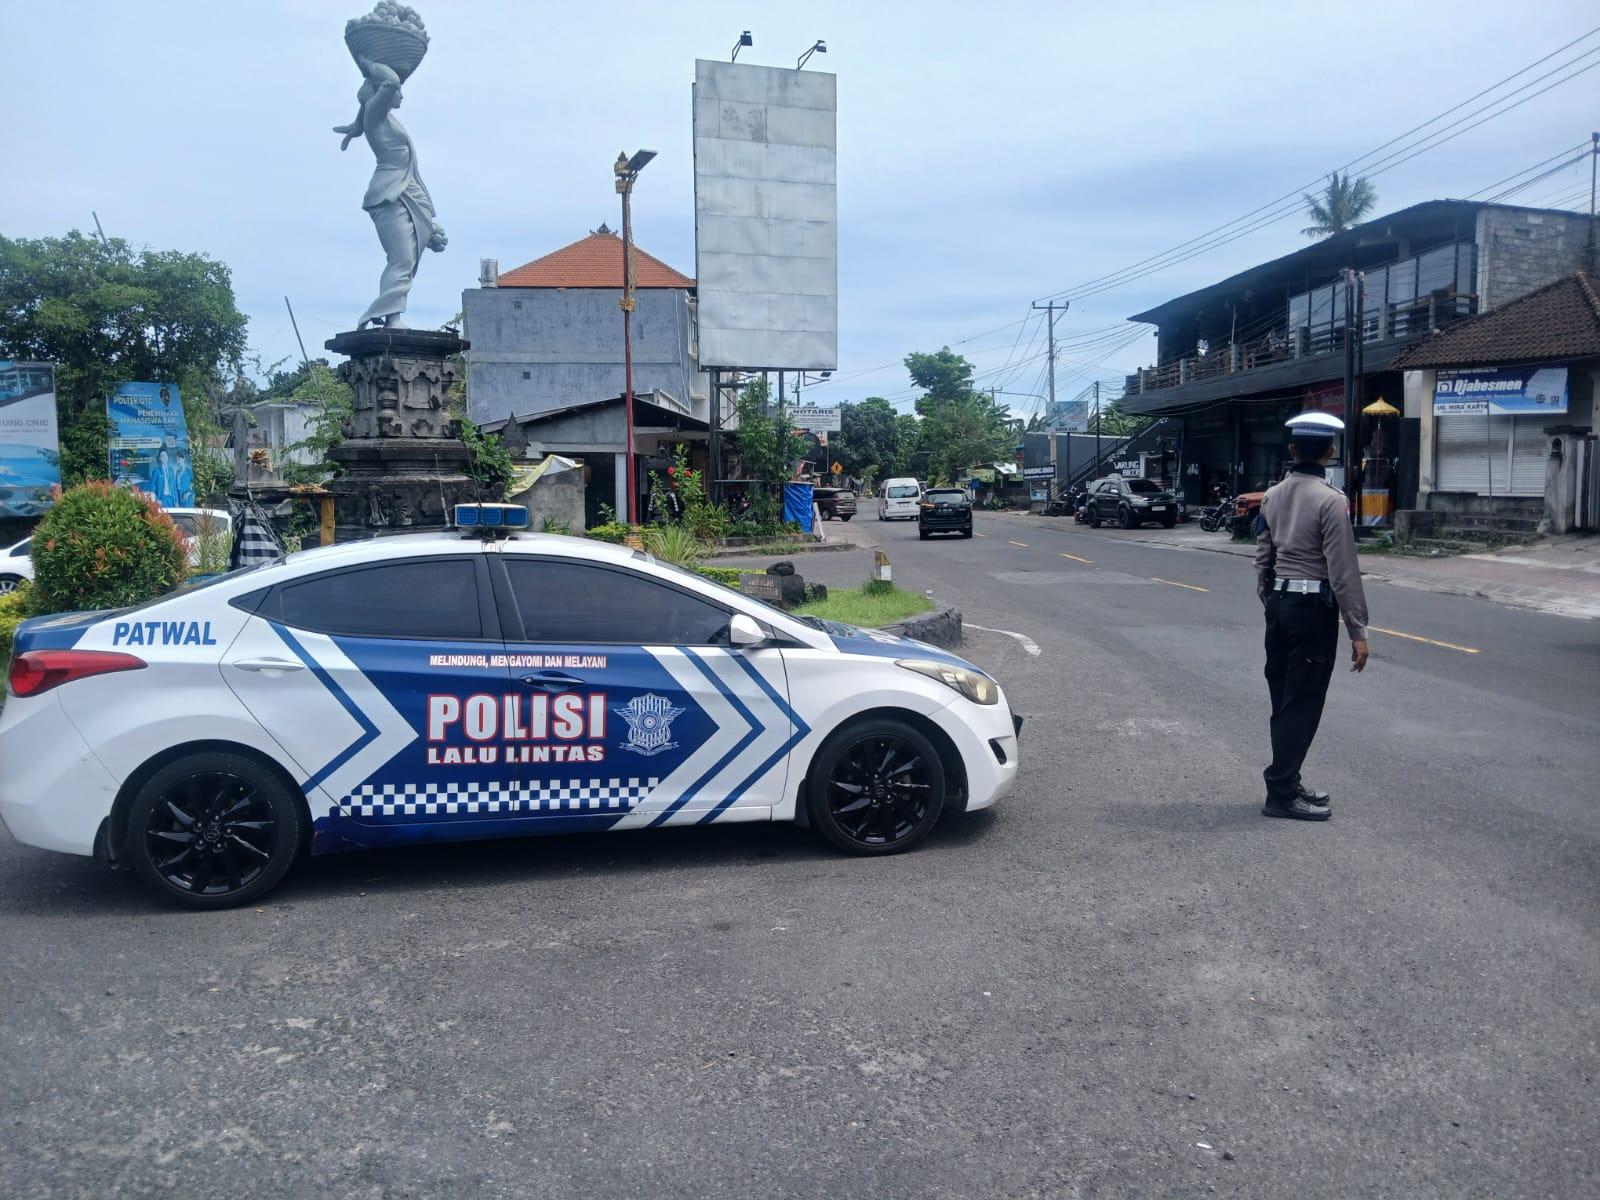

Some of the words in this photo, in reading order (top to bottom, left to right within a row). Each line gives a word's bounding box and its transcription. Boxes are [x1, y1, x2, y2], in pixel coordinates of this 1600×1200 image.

[1453, 379, 1523, 395] Djabesmen
[112, 621, 217, 646] PATWAL
[430, 655, 489, 668] MELINDUNGI,
[490, 656, 542, 667] MENGAYOMI
[544, 656, 562, 667] DAN
[564, 656, 606, 668] MELAYANI
[428, 692, 607, 742] POLISI
[428, 746, 498, 765] LALU
[504, 745, 605, 764] LINTAS
